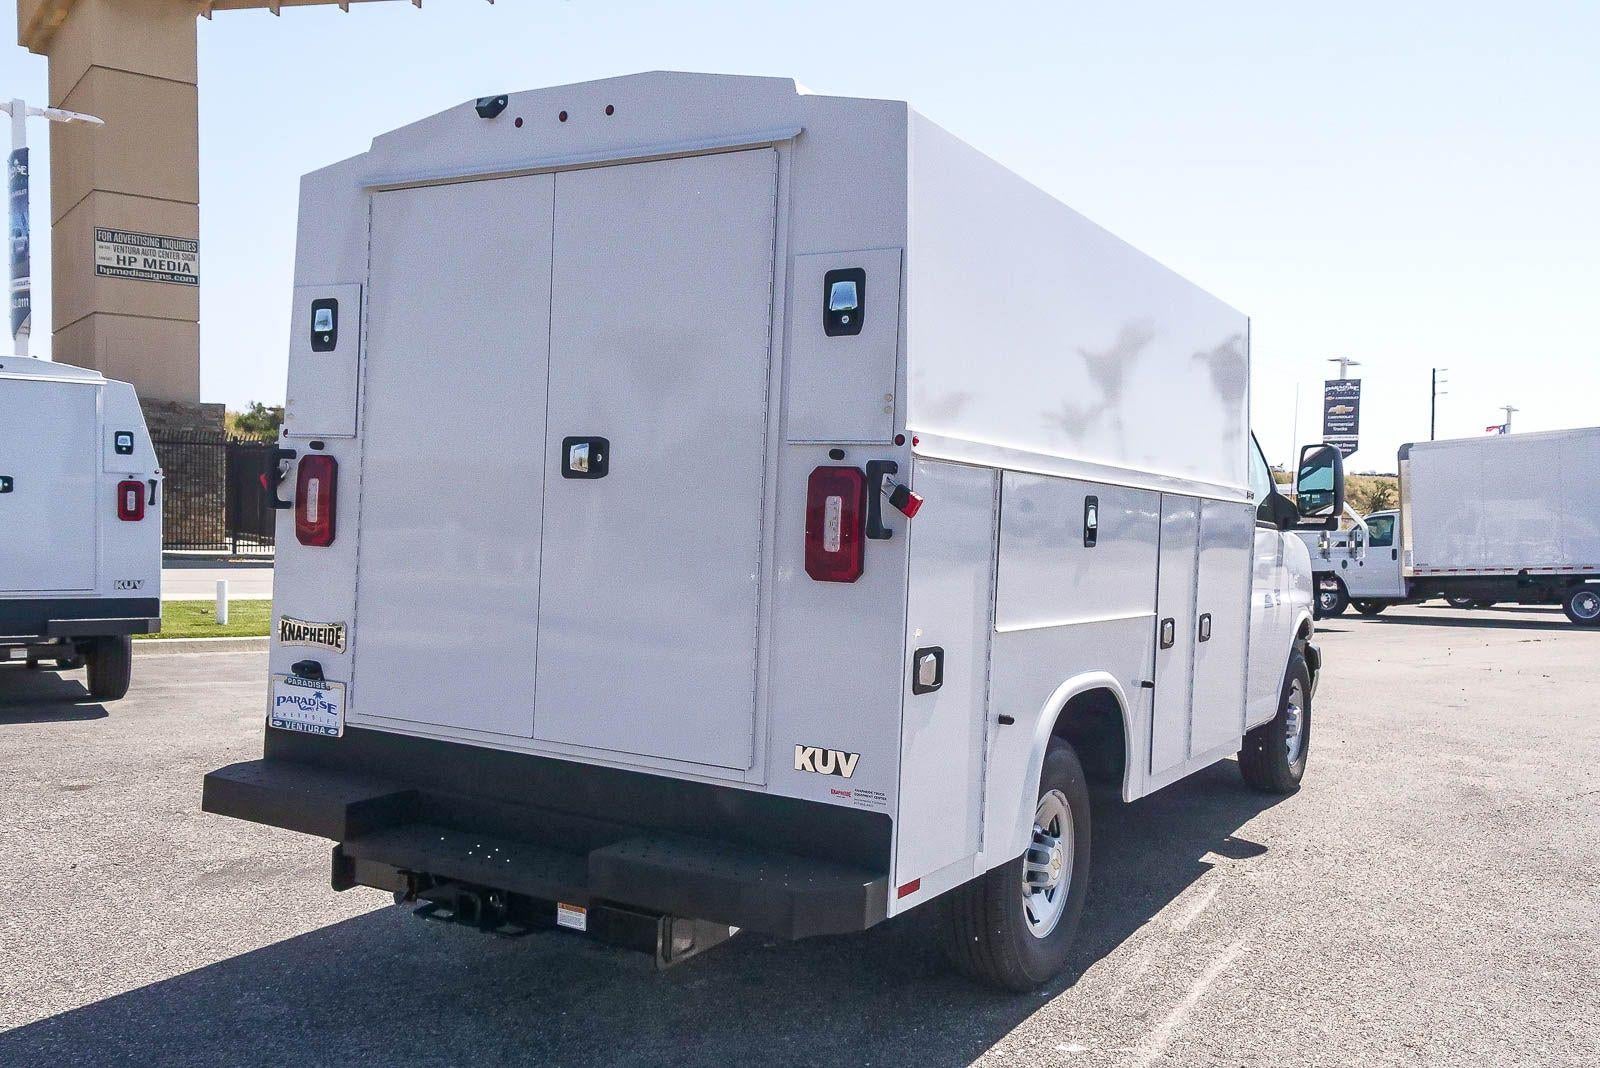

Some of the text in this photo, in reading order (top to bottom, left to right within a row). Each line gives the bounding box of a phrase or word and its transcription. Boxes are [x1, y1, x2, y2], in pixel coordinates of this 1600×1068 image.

[97, 230, 112, 242] FOR
[113, 233, 160, 248] ADVERTISING
[161, 238, 197, 252] INQUIRIES
[113, 244, 140, 255] VENTURA
[140, 248, 157, 258] AUTO
[158, 250, 180, 260] CENTER
[181, 253, 196, 262] SIGN
[116, 254, 191, 273] HP MEDIA
[99, 266, 195, 283] hpmediasigns.com
[113, 579, 145, 590] KUV
[280, 620, 342, 649] KNAPHEIDE
[287, 678, 326, 689] PARADISE
[276, 691, 337, 716] PARADISE
[285, 720, 326, 734] VENTURA
[794, 743, 861, 779] KUV
